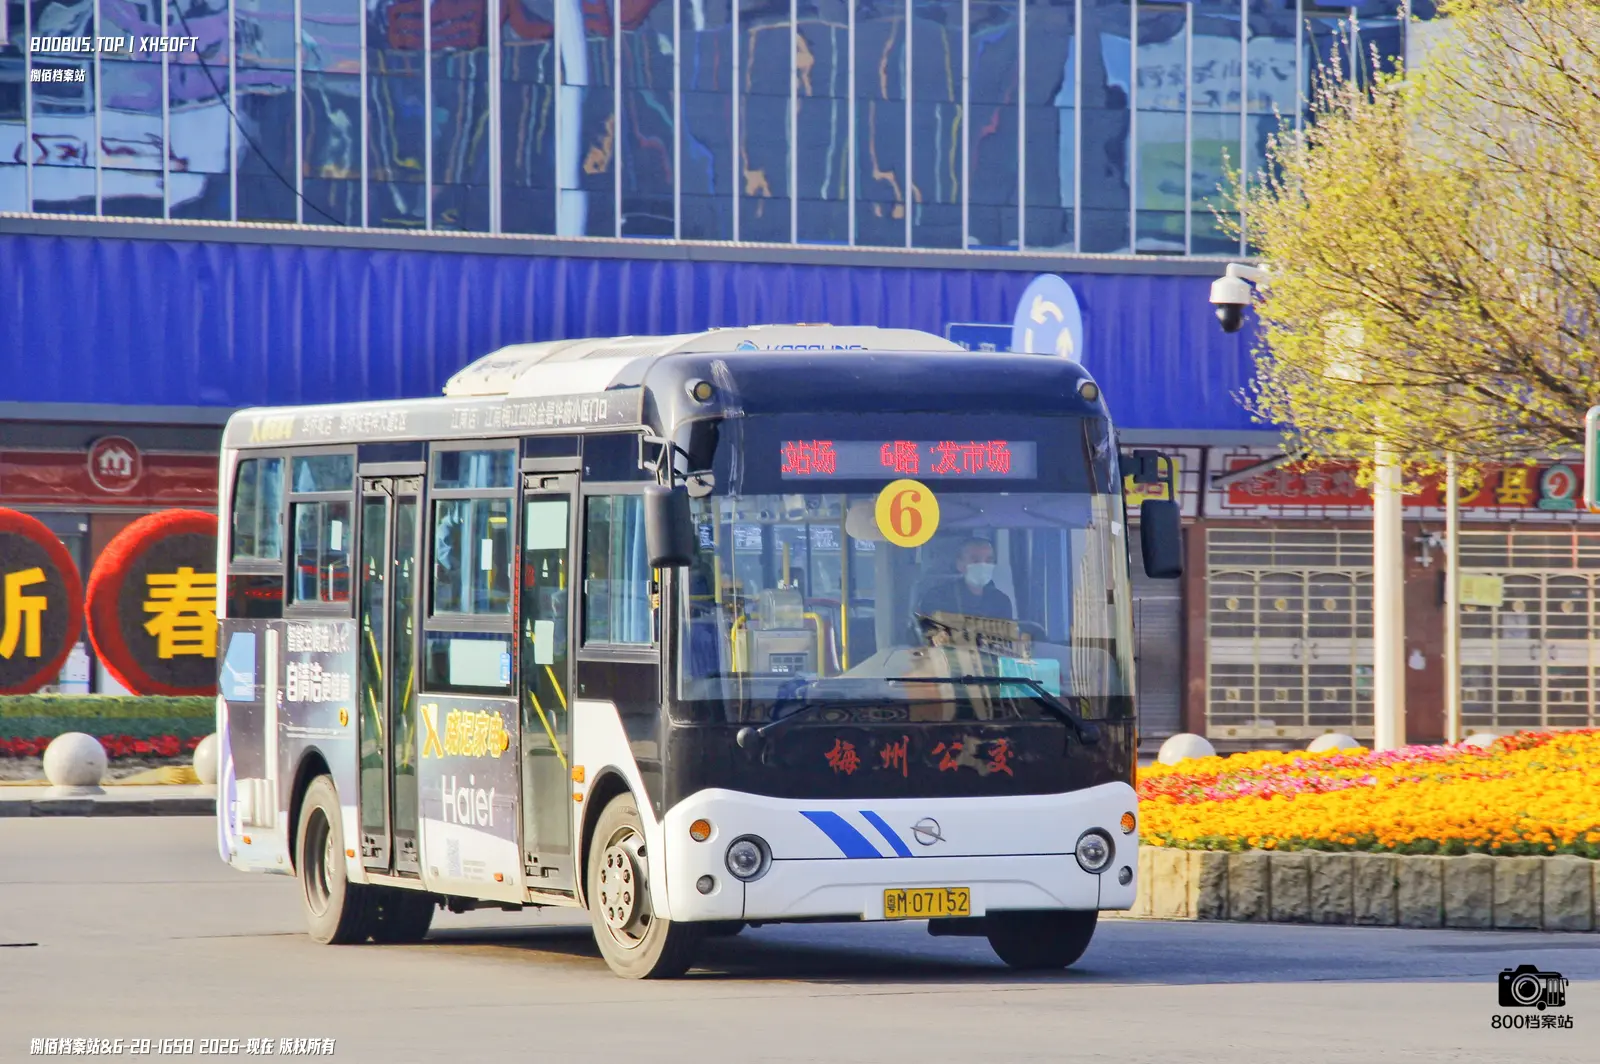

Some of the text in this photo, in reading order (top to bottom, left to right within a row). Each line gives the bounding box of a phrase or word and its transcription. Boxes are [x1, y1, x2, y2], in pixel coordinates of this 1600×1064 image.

[890, 489, 923, 537] 6
[824, 735, 1014, 778] 梅州公交
[441, 774, 496, 827] Haier
